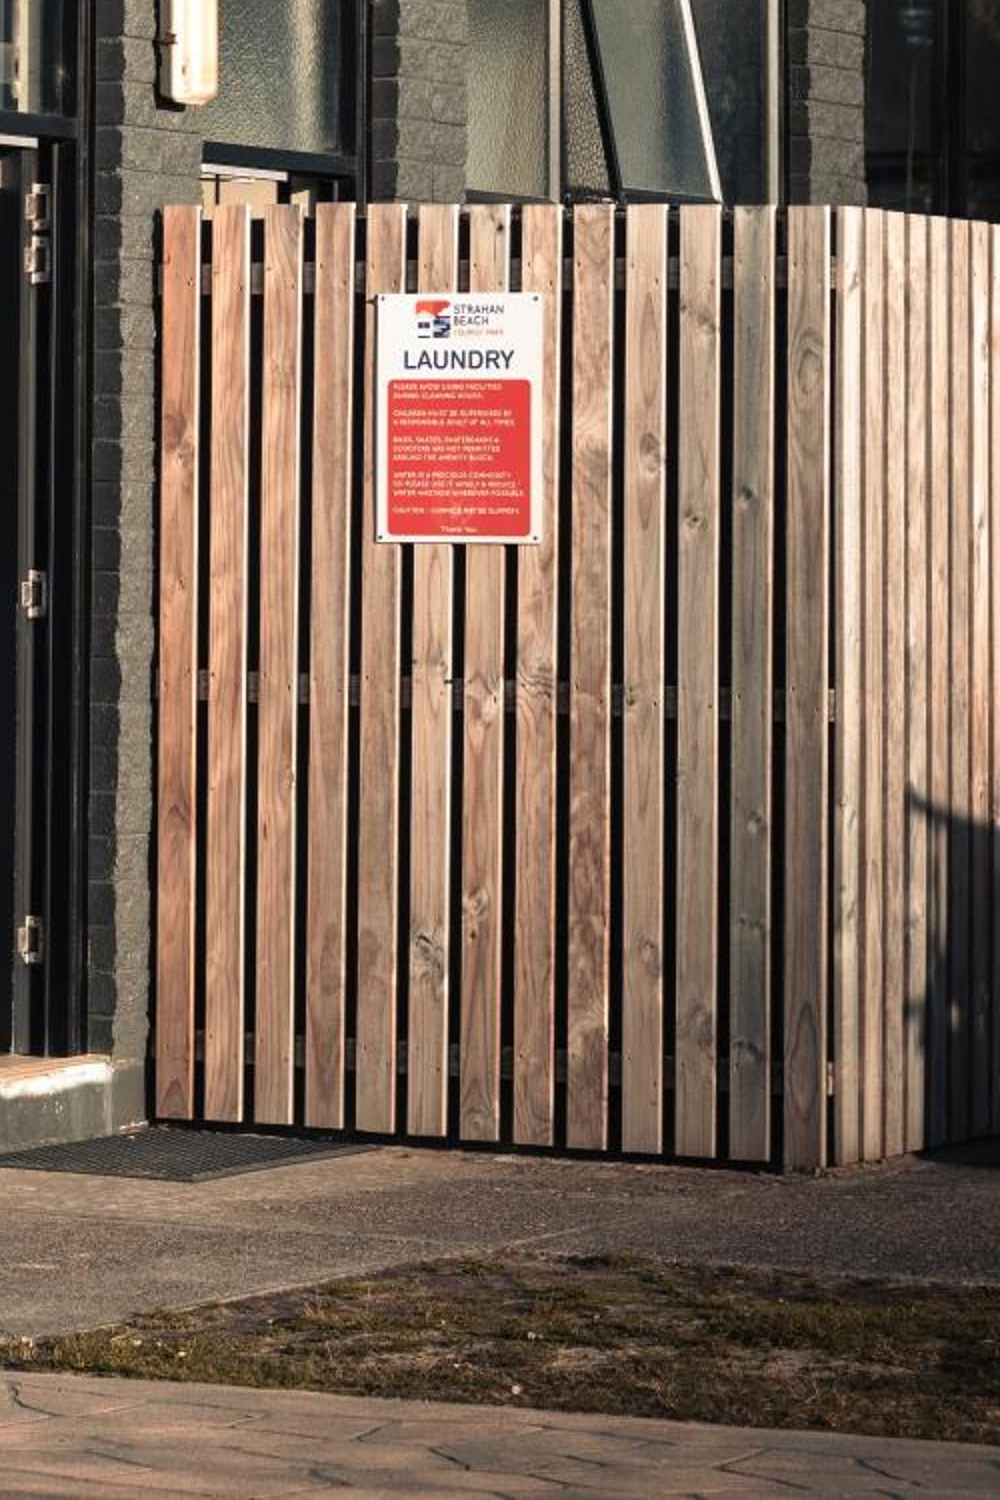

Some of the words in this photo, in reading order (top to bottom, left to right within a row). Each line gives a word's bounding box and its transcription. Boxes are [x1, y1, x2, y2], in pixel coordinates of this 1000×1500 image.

[453, 303, 504, 314] STRAHAN
[453, 316, 489, 326] BEACH
[403, 350, 515, 370] LAUNDRY
